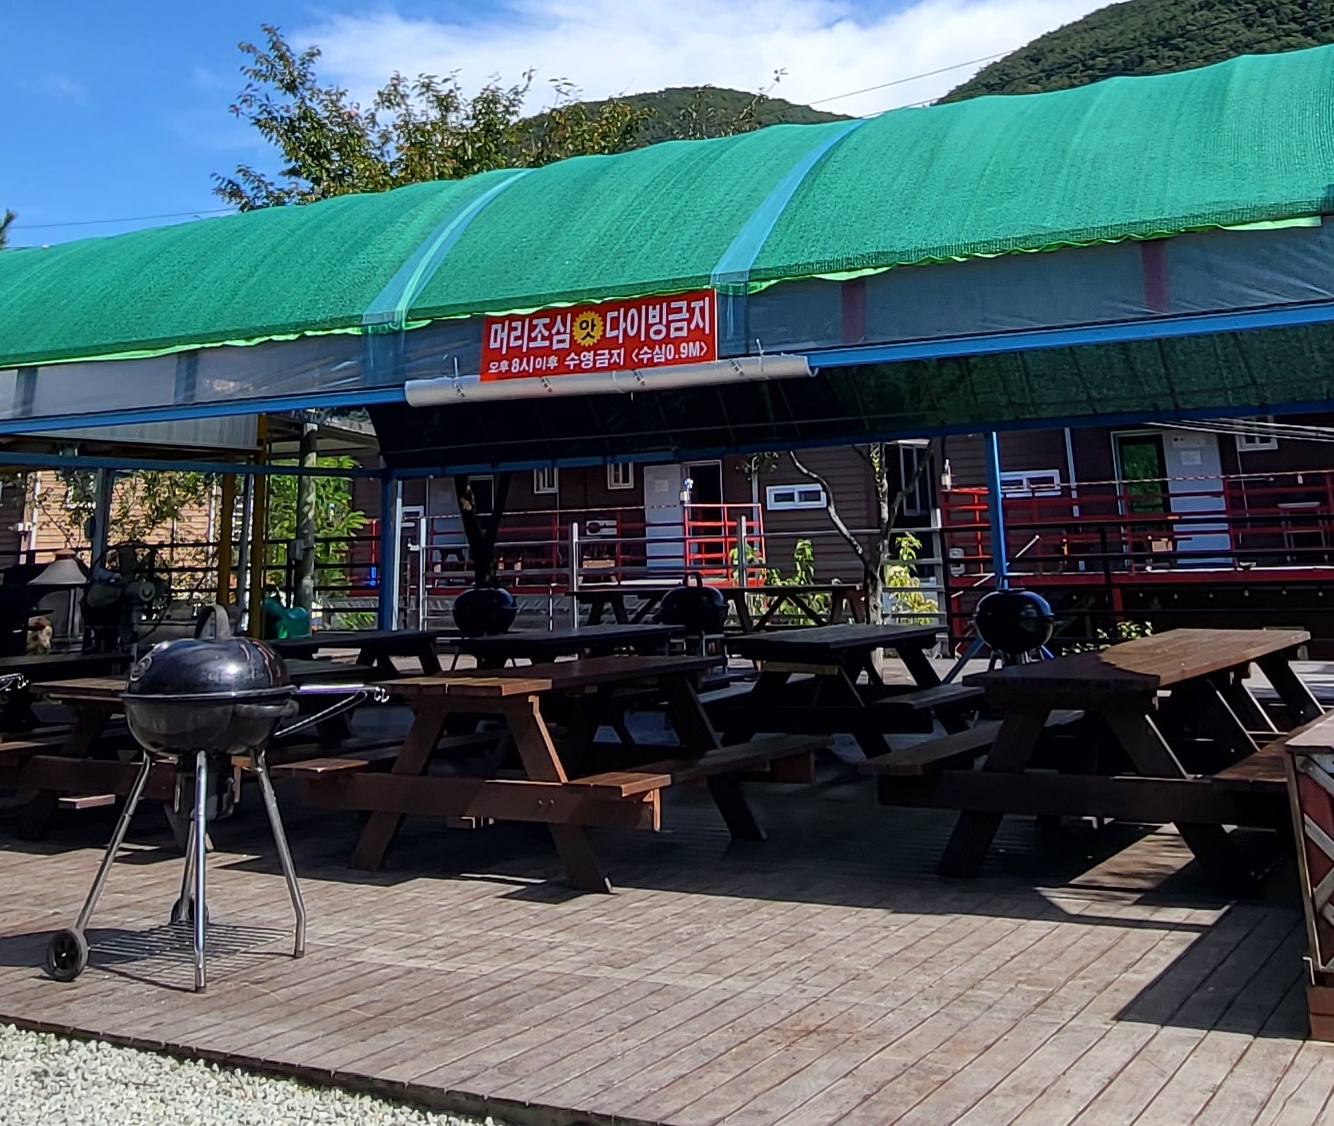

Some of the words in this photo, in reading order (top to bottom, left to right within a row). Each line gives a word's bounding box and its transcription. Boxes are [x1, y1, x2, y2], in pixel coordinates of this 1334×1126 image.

[489, 313, 571, 354] 머리조심
[579, 317, 597, 340] 앗
[606, 296, 710, 344] 다이빙금지
[564, 347, 624, 370] 수영금지
